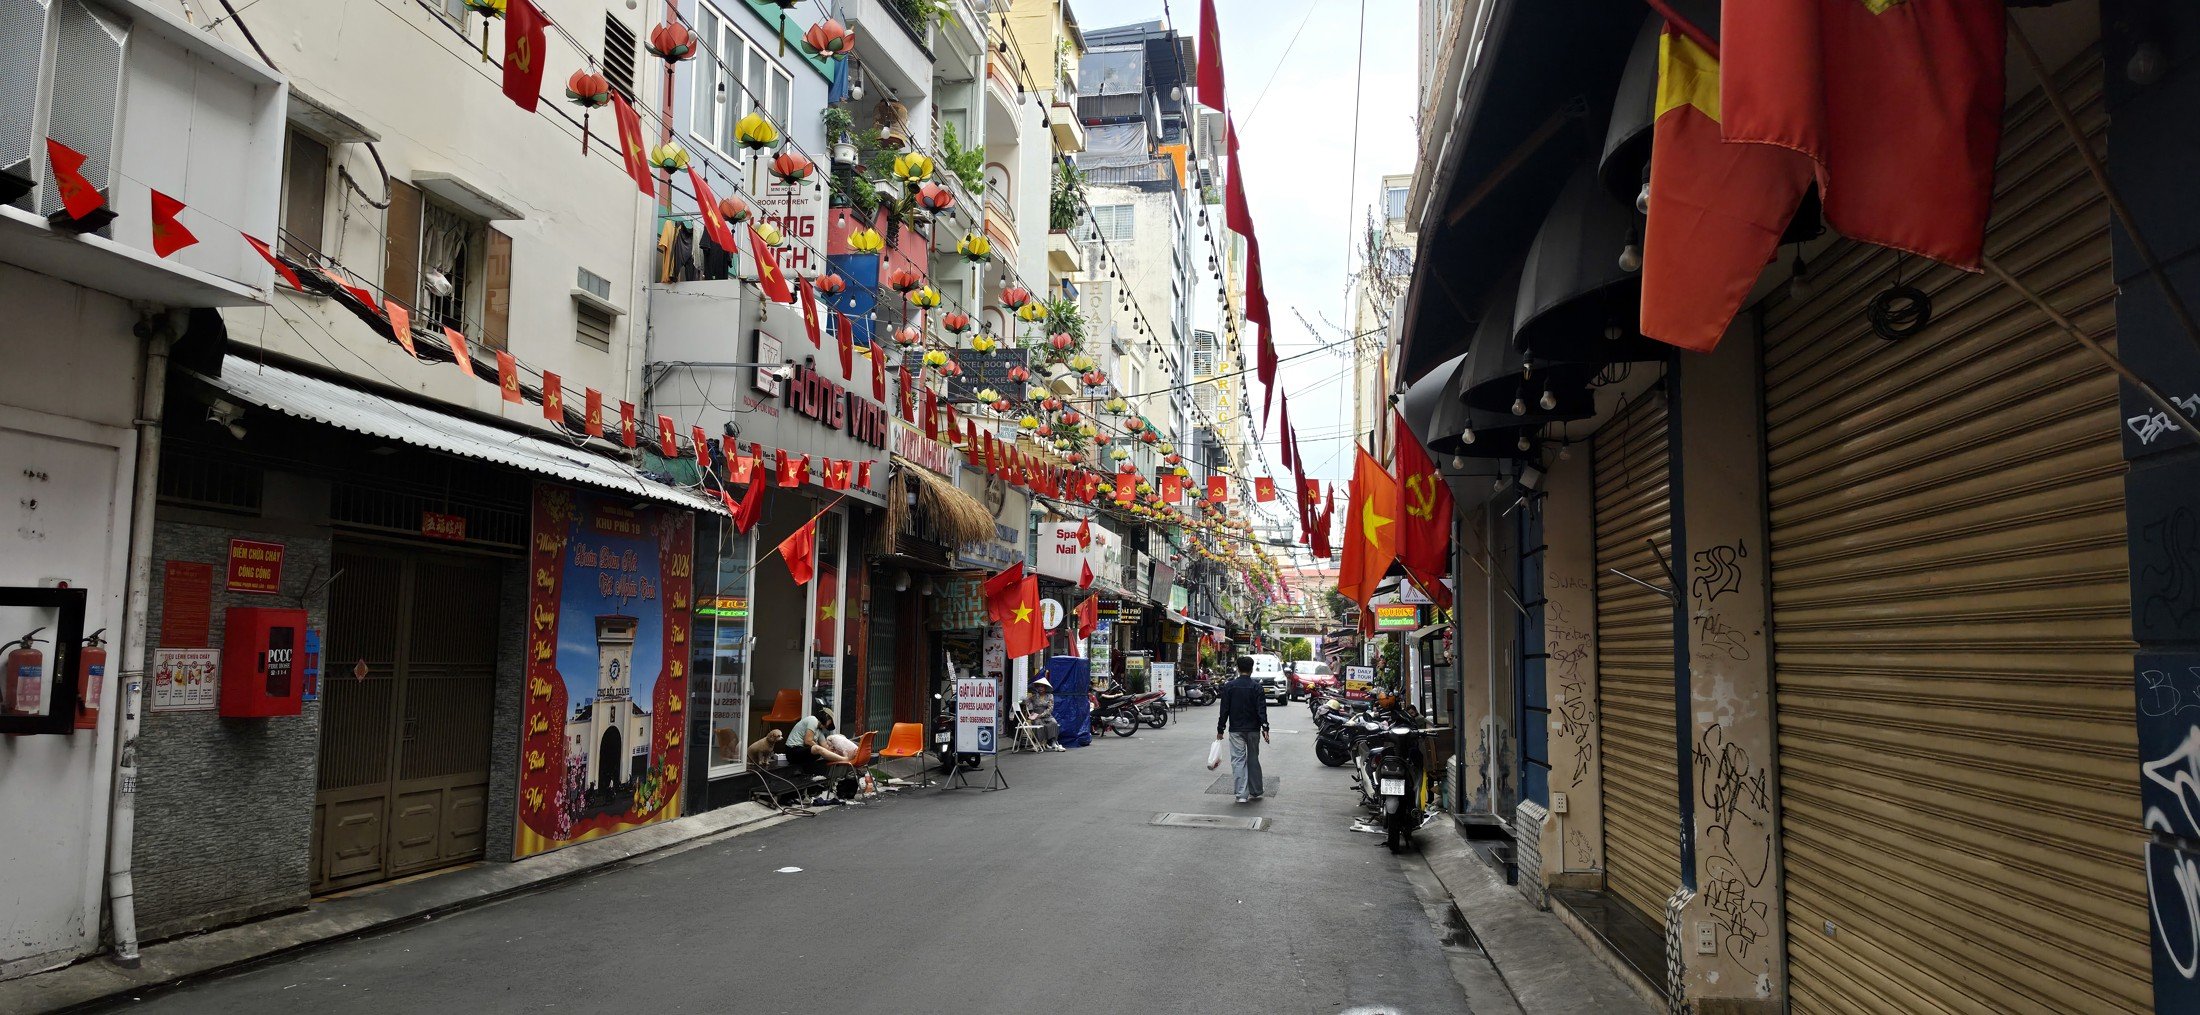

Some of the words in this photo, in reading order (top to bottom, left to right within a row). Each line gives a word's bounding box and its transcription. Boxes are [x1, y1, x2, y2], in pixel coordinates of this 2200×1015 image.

[786, 355, 845, 430] HỒNG
[1219, 362, 1229, 440] PRAGU
[846, 391, 888, 450] VINH
[596, 517, 612, 531] KHU
[614, 519, 630, 533] PHỐ
[1056, 529, 1077, 541] Spa
[1056, 544, 1077, 555] Nail
[671, 553, 690, 578] 2026
[1378, 608, 1414, 617] TOURIST
[1379, 618, 1414, 626] Information
[268, 649, 292, 663] PCCC
[959, 702, 976, 711] EXPRESS
[976, 702, 995, 711] LAUNDRY
